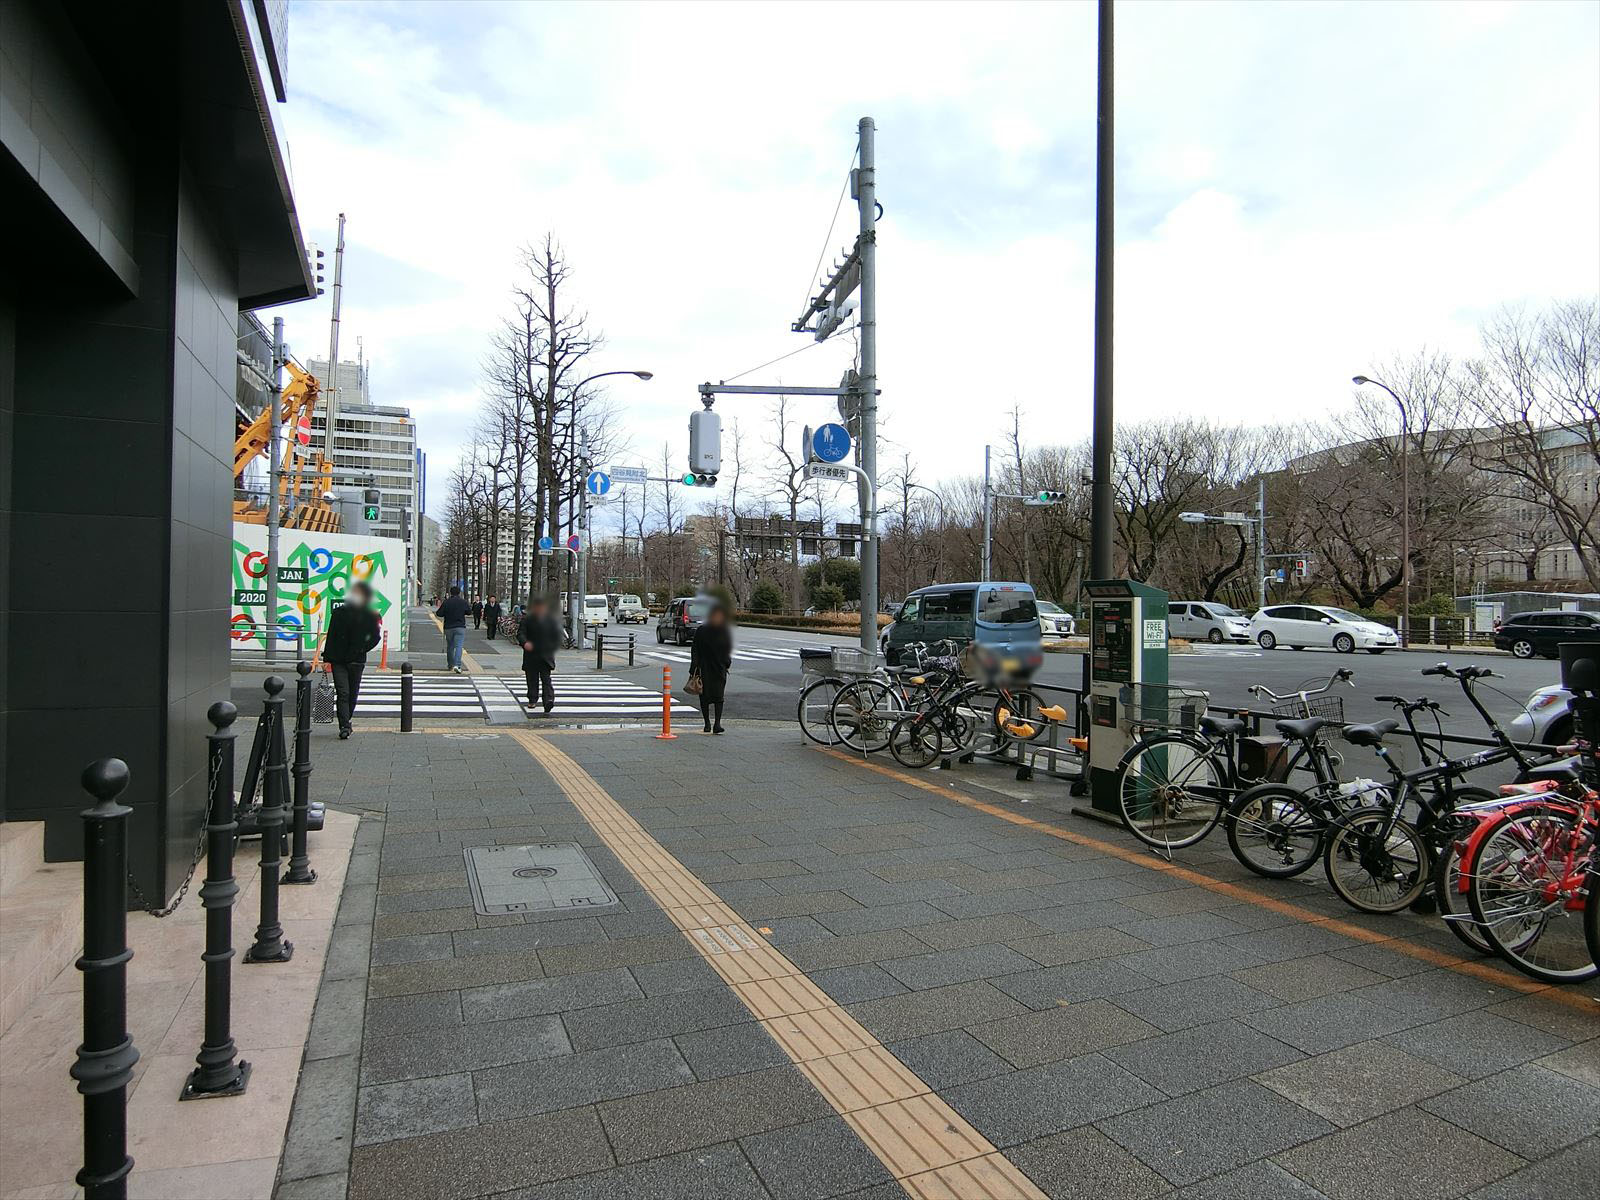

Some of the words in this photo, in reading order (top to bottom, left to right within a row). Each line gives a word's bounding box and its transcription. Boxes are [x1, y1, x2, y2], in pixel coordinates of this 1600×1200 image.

[812, 466, 846, 478] 歩行者優先
[240, 593, 266, 603] 2020
[1146, 623, 1162, 631] FREE
